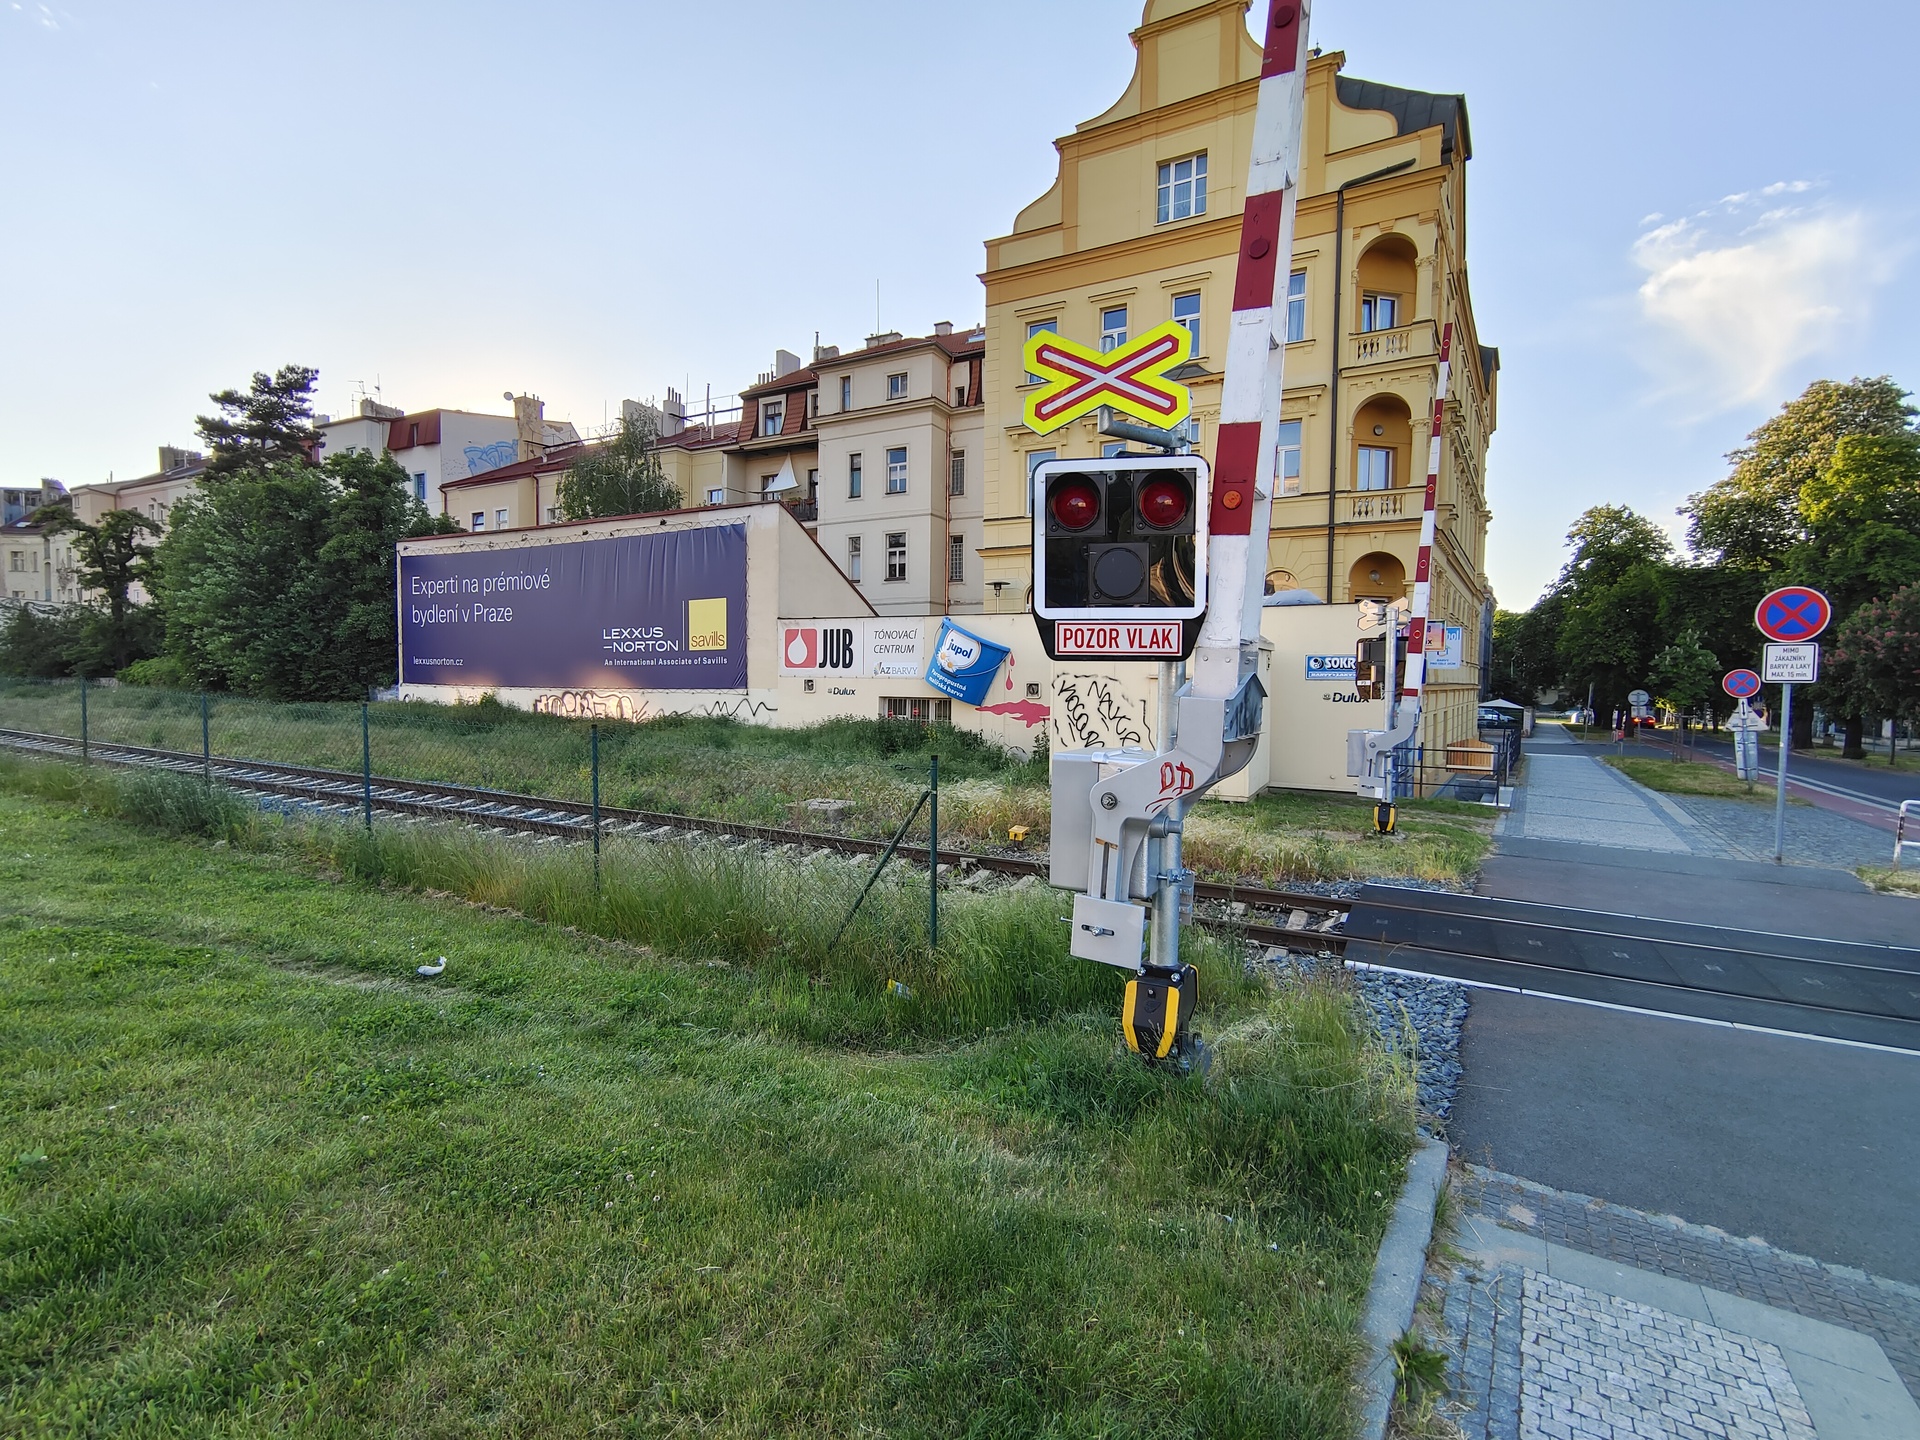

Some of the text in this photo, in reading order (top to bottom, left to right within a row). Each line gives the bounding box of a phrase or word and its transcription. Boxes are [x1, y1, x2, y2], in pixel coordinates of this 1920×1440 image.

[411, 567, 551, 598] Experti na prémiové
[411, 603, 513, 628] bydlení v Praze
[603, 626, 664, 640] LEXXUS
[690, 631, 726, 648] savills
[873, 627, 918, 640] TÓNOVACÍ
[1063, 627, 1173, 649] POZOR VLAK
[818, 628, 854, 669] JUB
[873, 644, 915, 654] CENTRUM
[946, 638, 974, 659] jupol
[413, 656, 464, 666] lexxusnorton.cz
[604, 656, 728, 666] An International Associate of Savills
[833, 687, 856, 696] Dulux
[946, 684, 964, 698] barva
